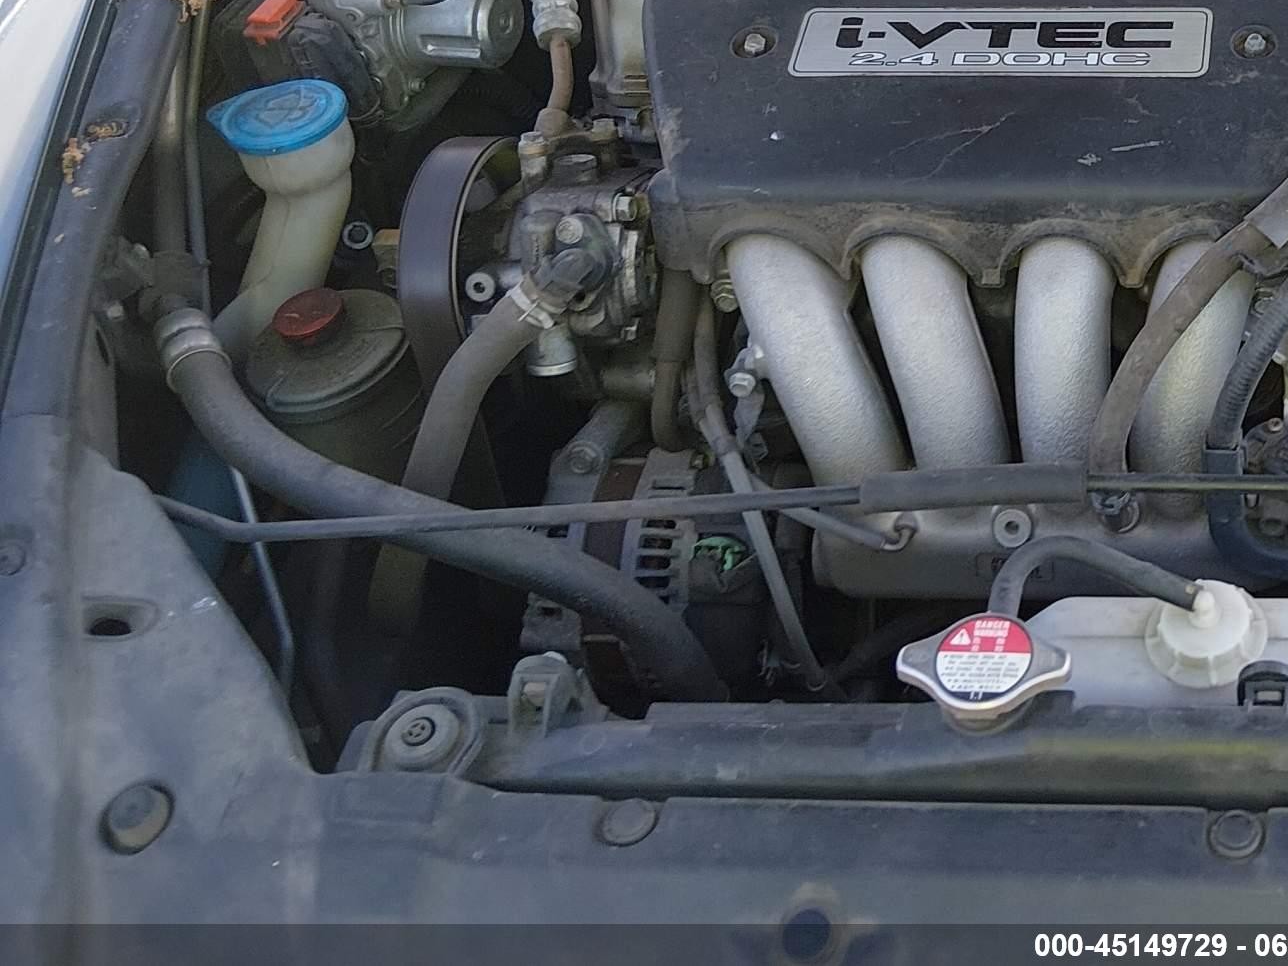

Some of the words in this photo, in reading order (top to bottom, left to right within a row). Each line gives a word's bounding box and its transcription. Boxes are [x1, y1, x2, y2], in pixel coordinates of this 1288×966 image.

[835, 17, 1174, 49] i-VTEC
[849, 52, 938, 66] 2.4
[952, 52, 1150, 66] DOHC
